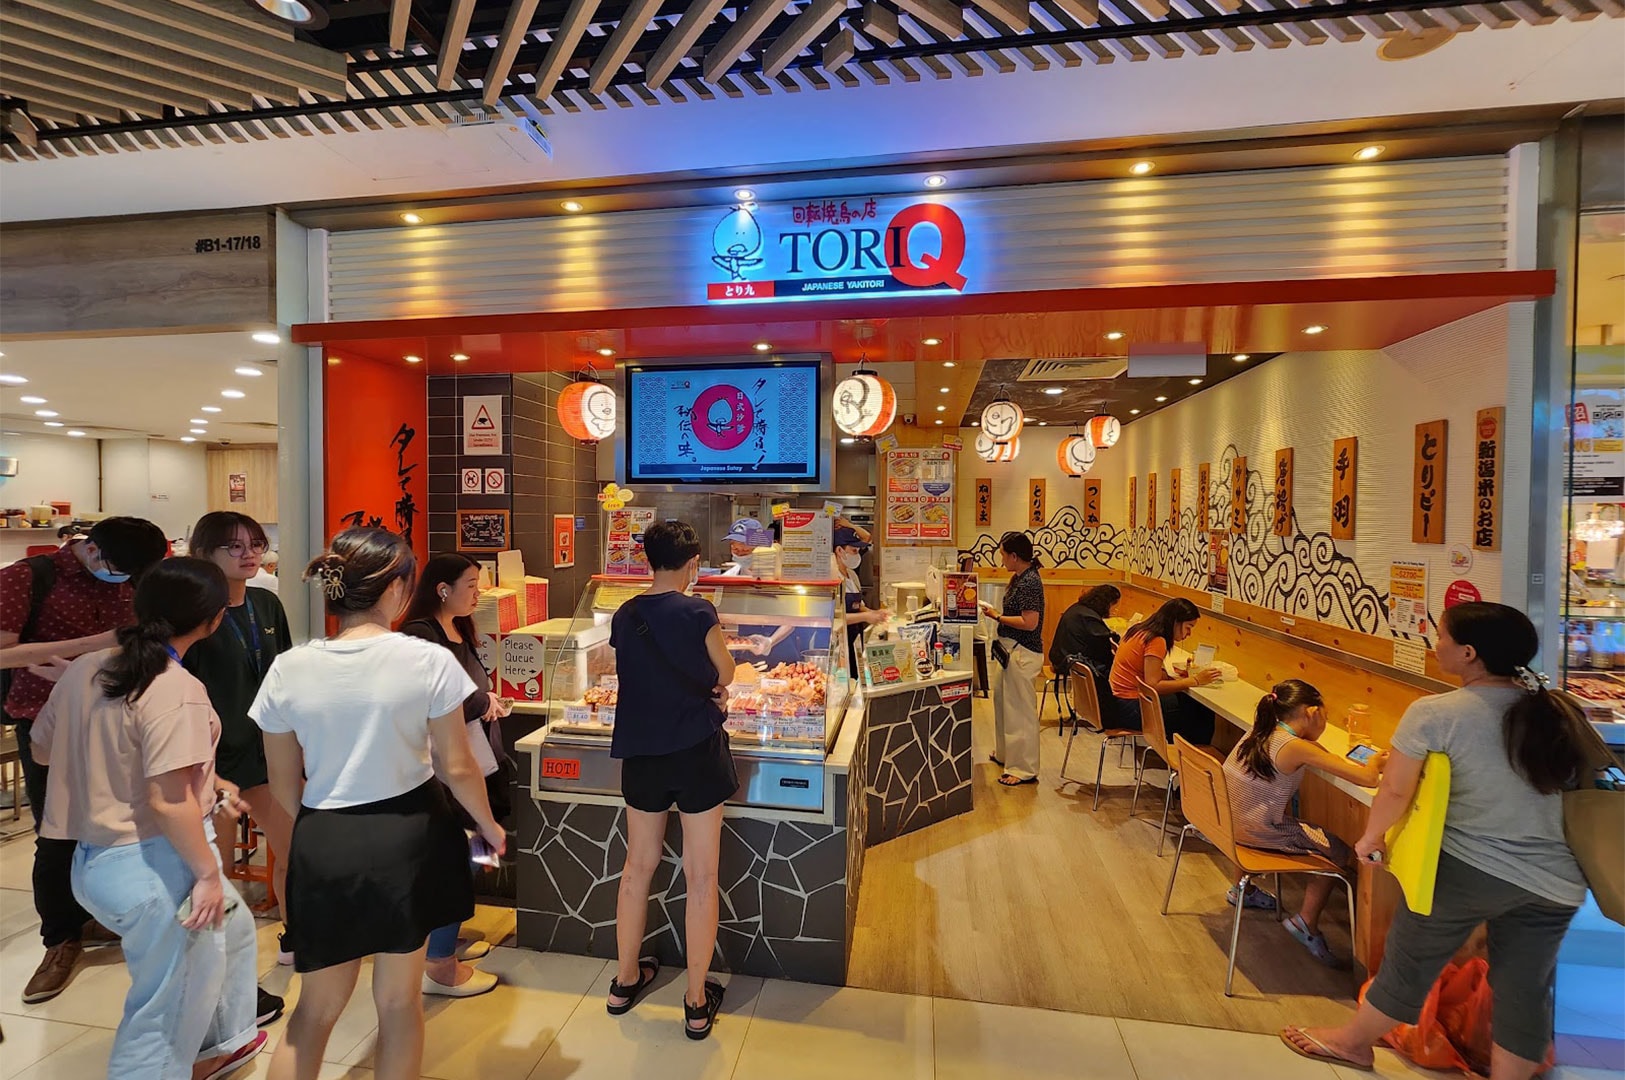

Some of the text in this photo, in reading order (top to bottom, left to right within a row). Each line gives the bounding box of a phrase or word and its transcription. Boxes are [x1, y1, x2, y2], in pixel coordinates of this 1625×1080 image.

[793, 199, 876, 227] 回転焼鳥の店
[195, 236, 261, 253] #B1-17/18
[801, 279, 885, 291] JAPANESE YAKITORI
[1333, 447, 1350, 528] 手羽
[1421, 433, 1438, 537] とりピー
[1477, 441, 1497, 547] 新潟米のお店
[979, 484, 990, 522] ねぎま
[1088, 486, 1099, 524] つくね
[505, 639, 534, 650] Please
[505, 653, 534, 663] Queue
[505, 665, 526, 676] Here
[546, 762, 577, 775] HOT!
